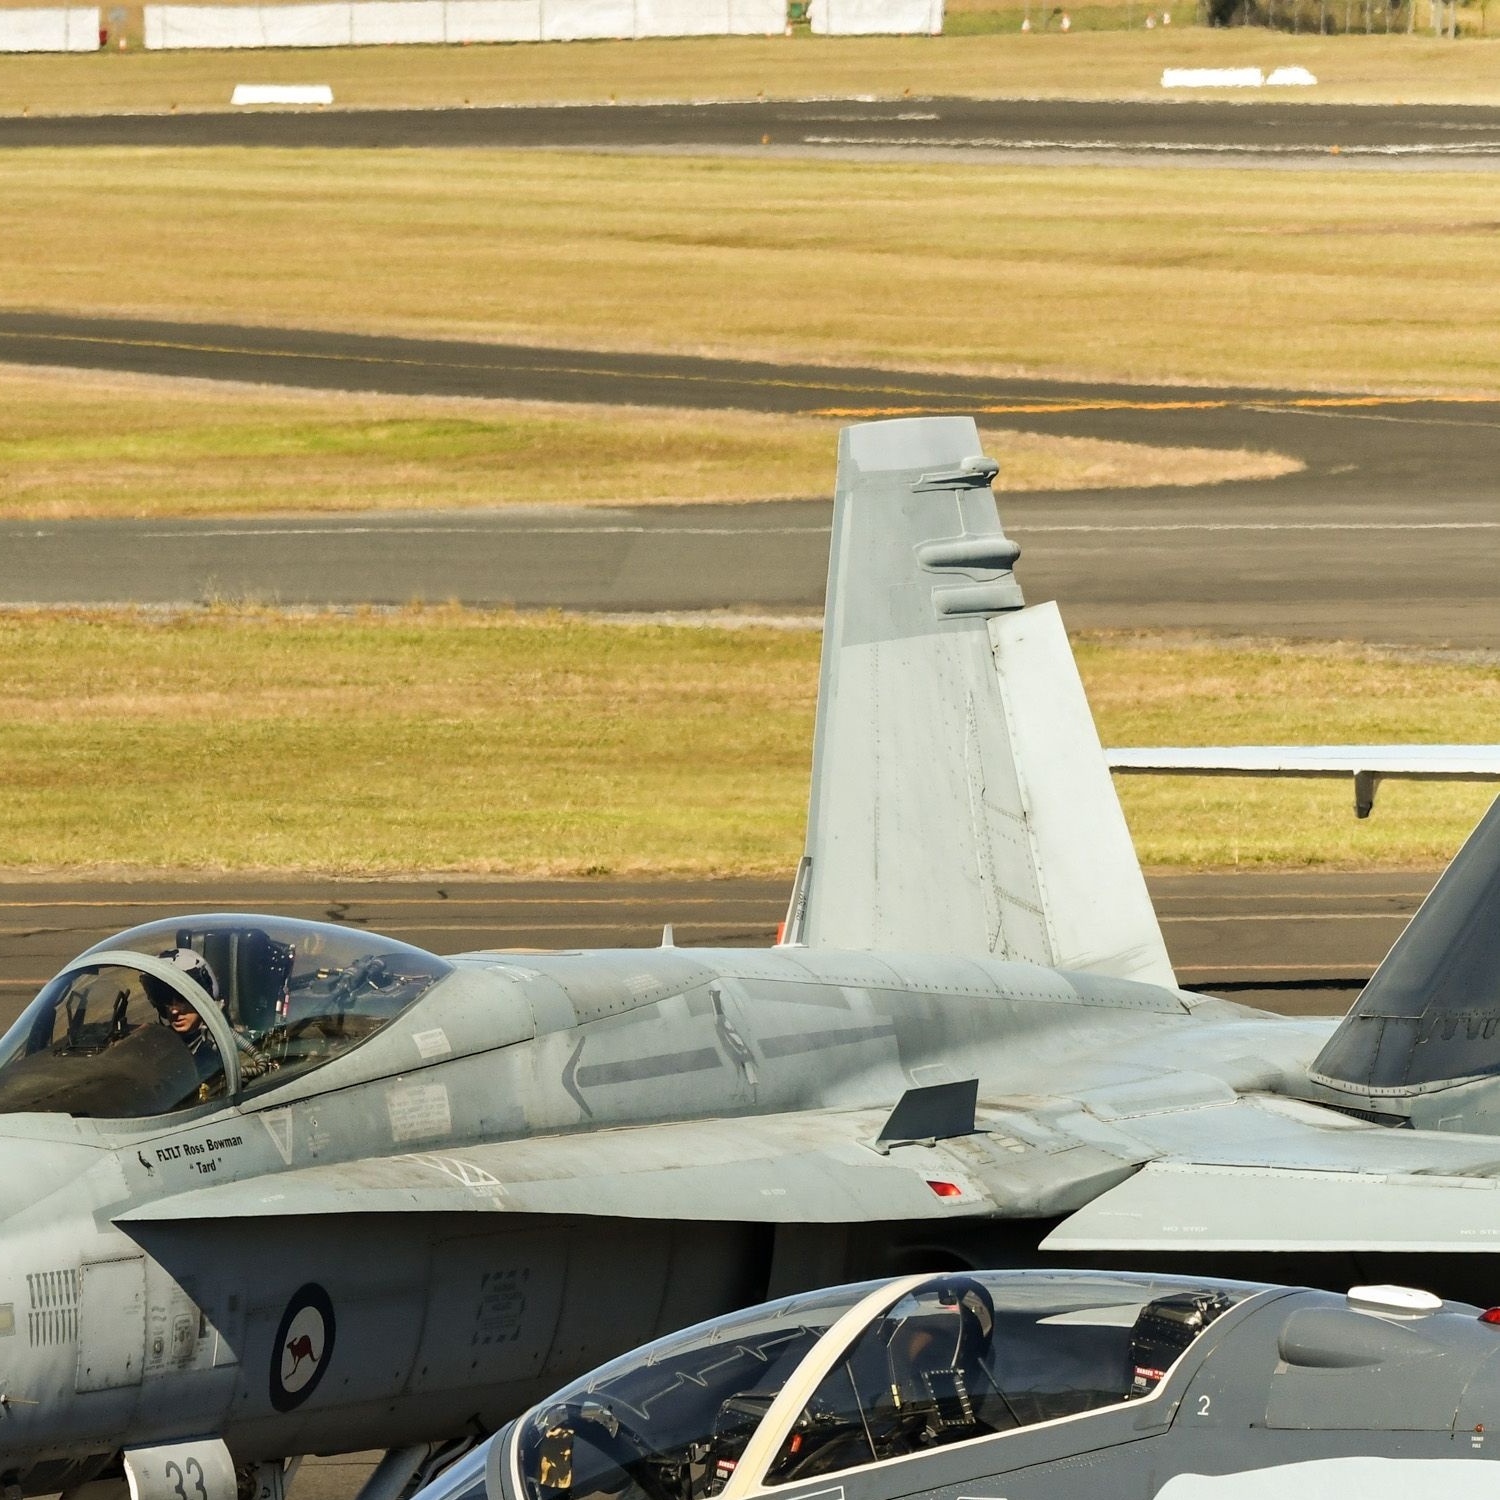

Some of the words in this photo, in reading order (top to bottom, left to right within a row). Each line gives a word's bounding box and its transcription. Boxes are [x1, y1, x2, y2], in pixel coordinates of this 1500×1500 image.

[156, 1145, 182, 1163] FLTLT
[183, 1141, 205, 1158] Ross
[206, 1134, 243, 1152] Bowman
